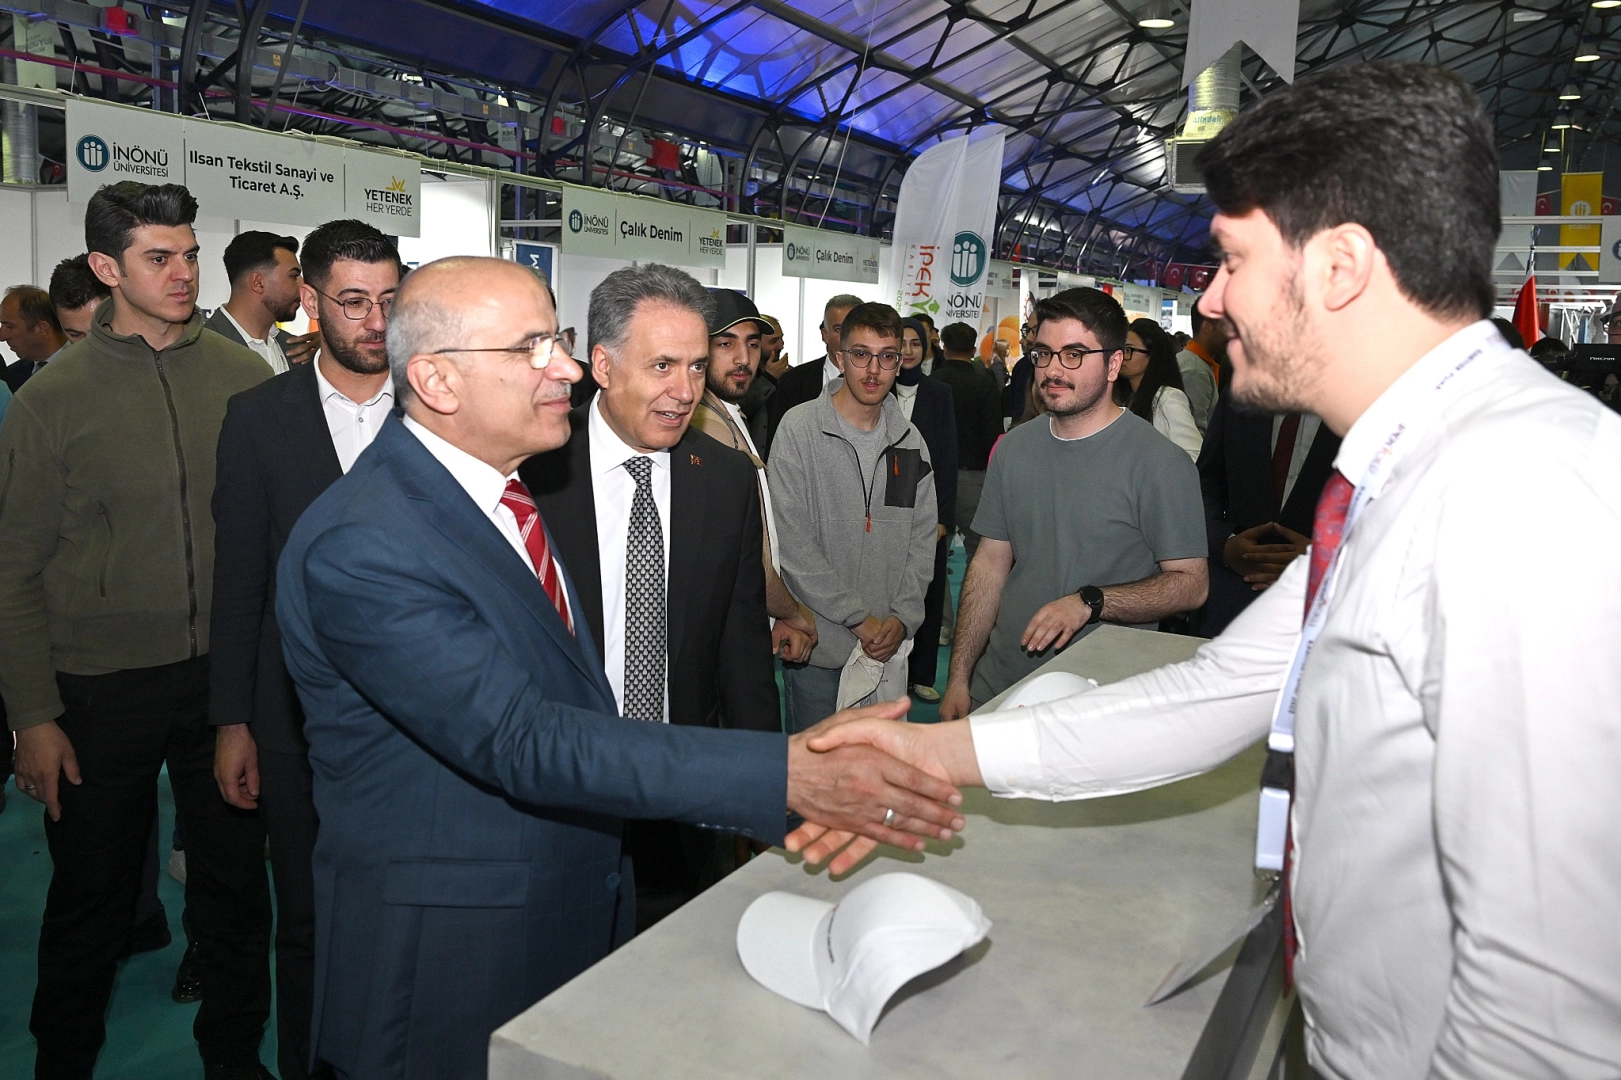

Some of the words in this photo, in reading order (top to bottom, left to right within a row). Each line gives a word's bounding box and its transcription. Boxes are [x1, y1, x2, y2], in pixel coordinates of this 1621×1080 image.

[113, 141, 168, 167] İNÖNÜ
[113, 160, 169, 178] ÜNİVERSİTESİ
[226, 155, 272, 175] Tekstil
[275, 163, 317, 183] Sanayi
[319, 171, 334, 183] ve
[229, 175, 277, 194] Ticaret
[279, 182, 304, 200] A.Ş.
[364, 187, 413, 206] YETENEK
[366, 201, 384, 214] HER
[385, 203, 413, 217] YERDE
[583, 212, 609, 229] İNÖNÜ
[620, 220, 648, 239] Çalık
[649, 224, 683, 243] Denim
[698, 236, 724, 248] YETENEK
[816, 249, 833, 264] Çalık
[833, 251, 854, 265] Denim
[947, 291, 982, 309] NÖNÜ
